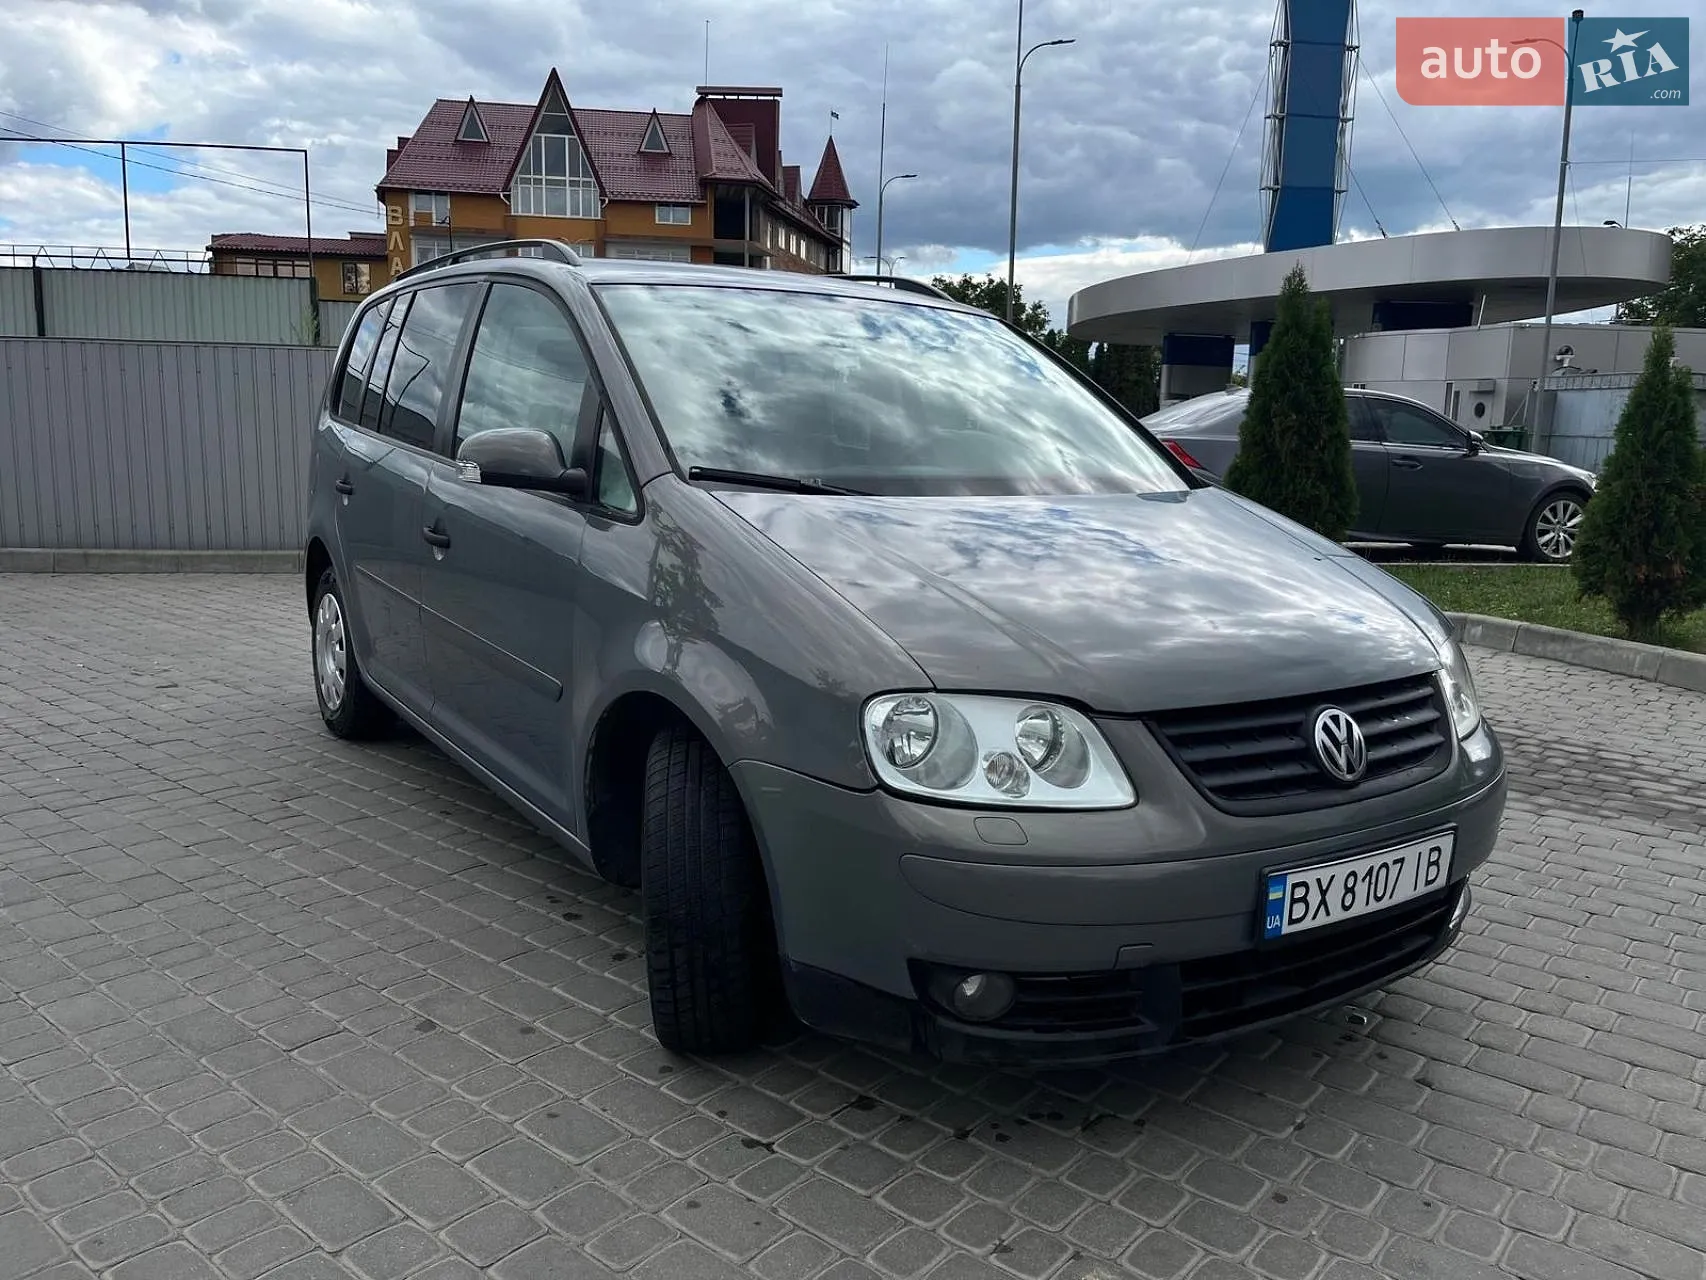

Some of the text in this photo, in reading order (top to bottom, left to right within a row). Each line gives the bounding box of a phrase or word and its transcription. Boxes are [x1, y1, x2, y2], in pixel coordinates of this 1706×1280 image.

[1287, 846, 1442, 926] BX 8107 IB
[1266, 914, 1281, 929] UA
